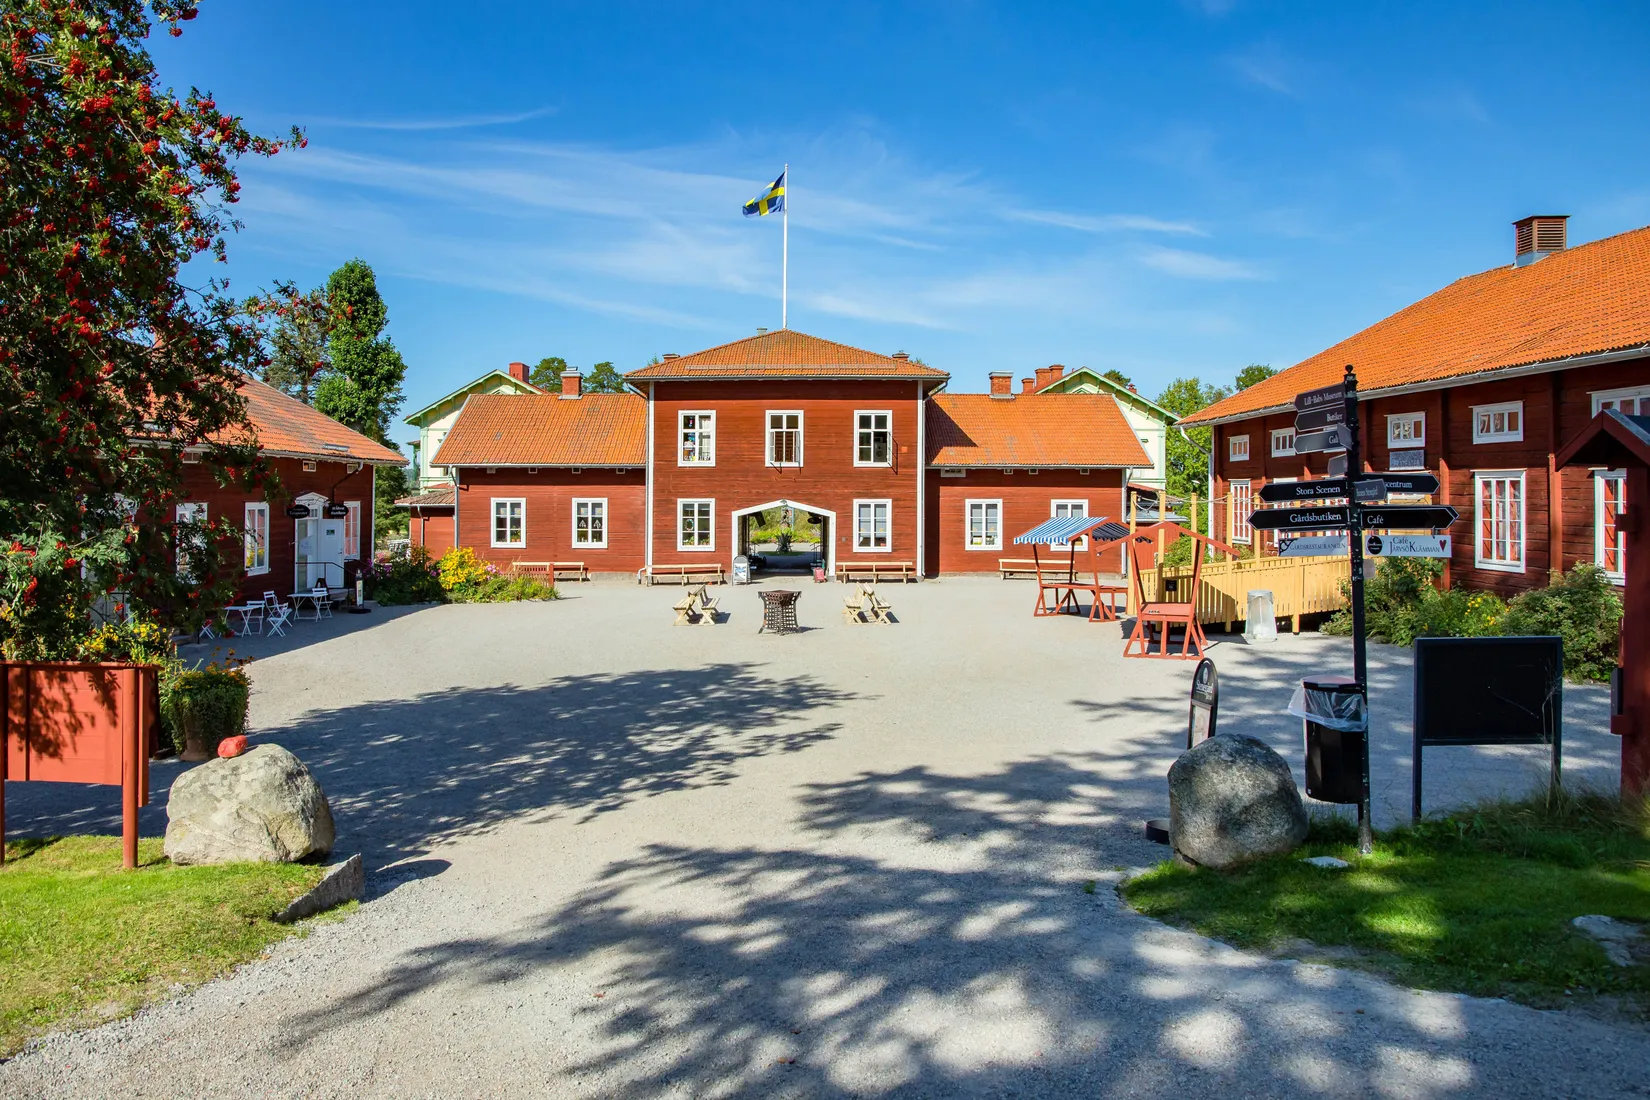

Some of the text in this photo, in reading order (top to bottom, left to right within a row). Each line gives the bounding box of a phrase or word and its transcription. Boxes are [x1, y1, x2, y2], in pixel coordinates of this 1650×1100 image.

[1295, 485, 1341, 496] Stora Scenen
[1289, 512, 1342, 523] Gårdsbutiken
[1366, 515, 1384, 525] Café
[1392, 536, 1409, 545] Café
